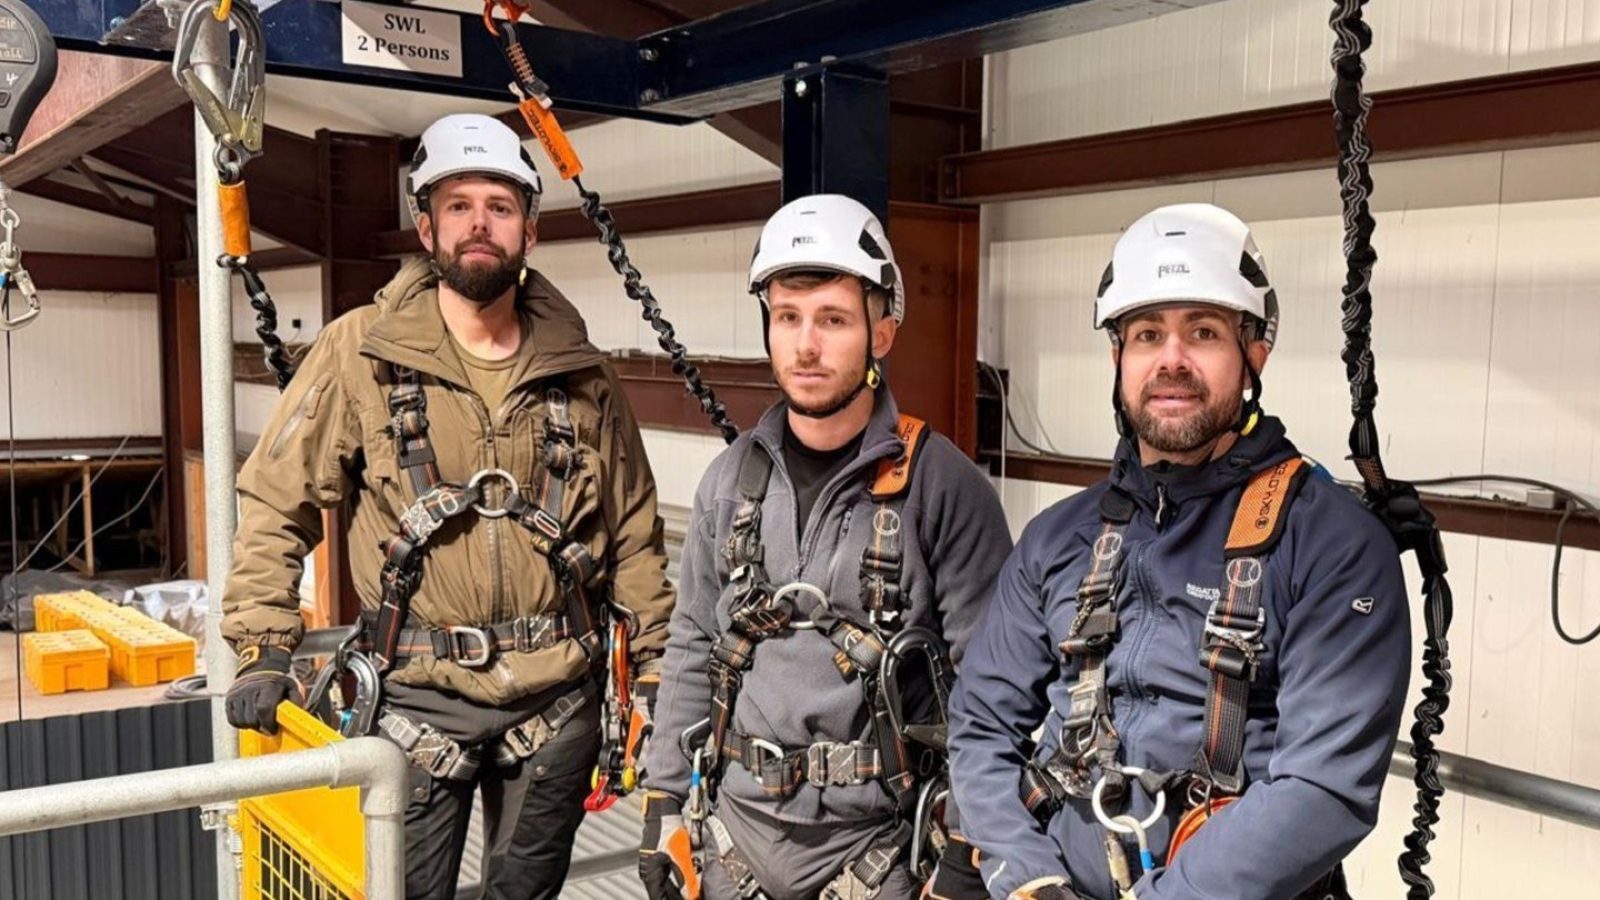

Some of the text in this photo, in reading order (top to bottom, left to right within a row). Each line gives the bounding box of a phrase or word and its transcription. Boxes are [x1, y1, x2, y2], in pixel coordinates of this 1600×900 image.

[384, 13, 426, 34] SWL
[357, 35, 450, 61] 2 Persons
